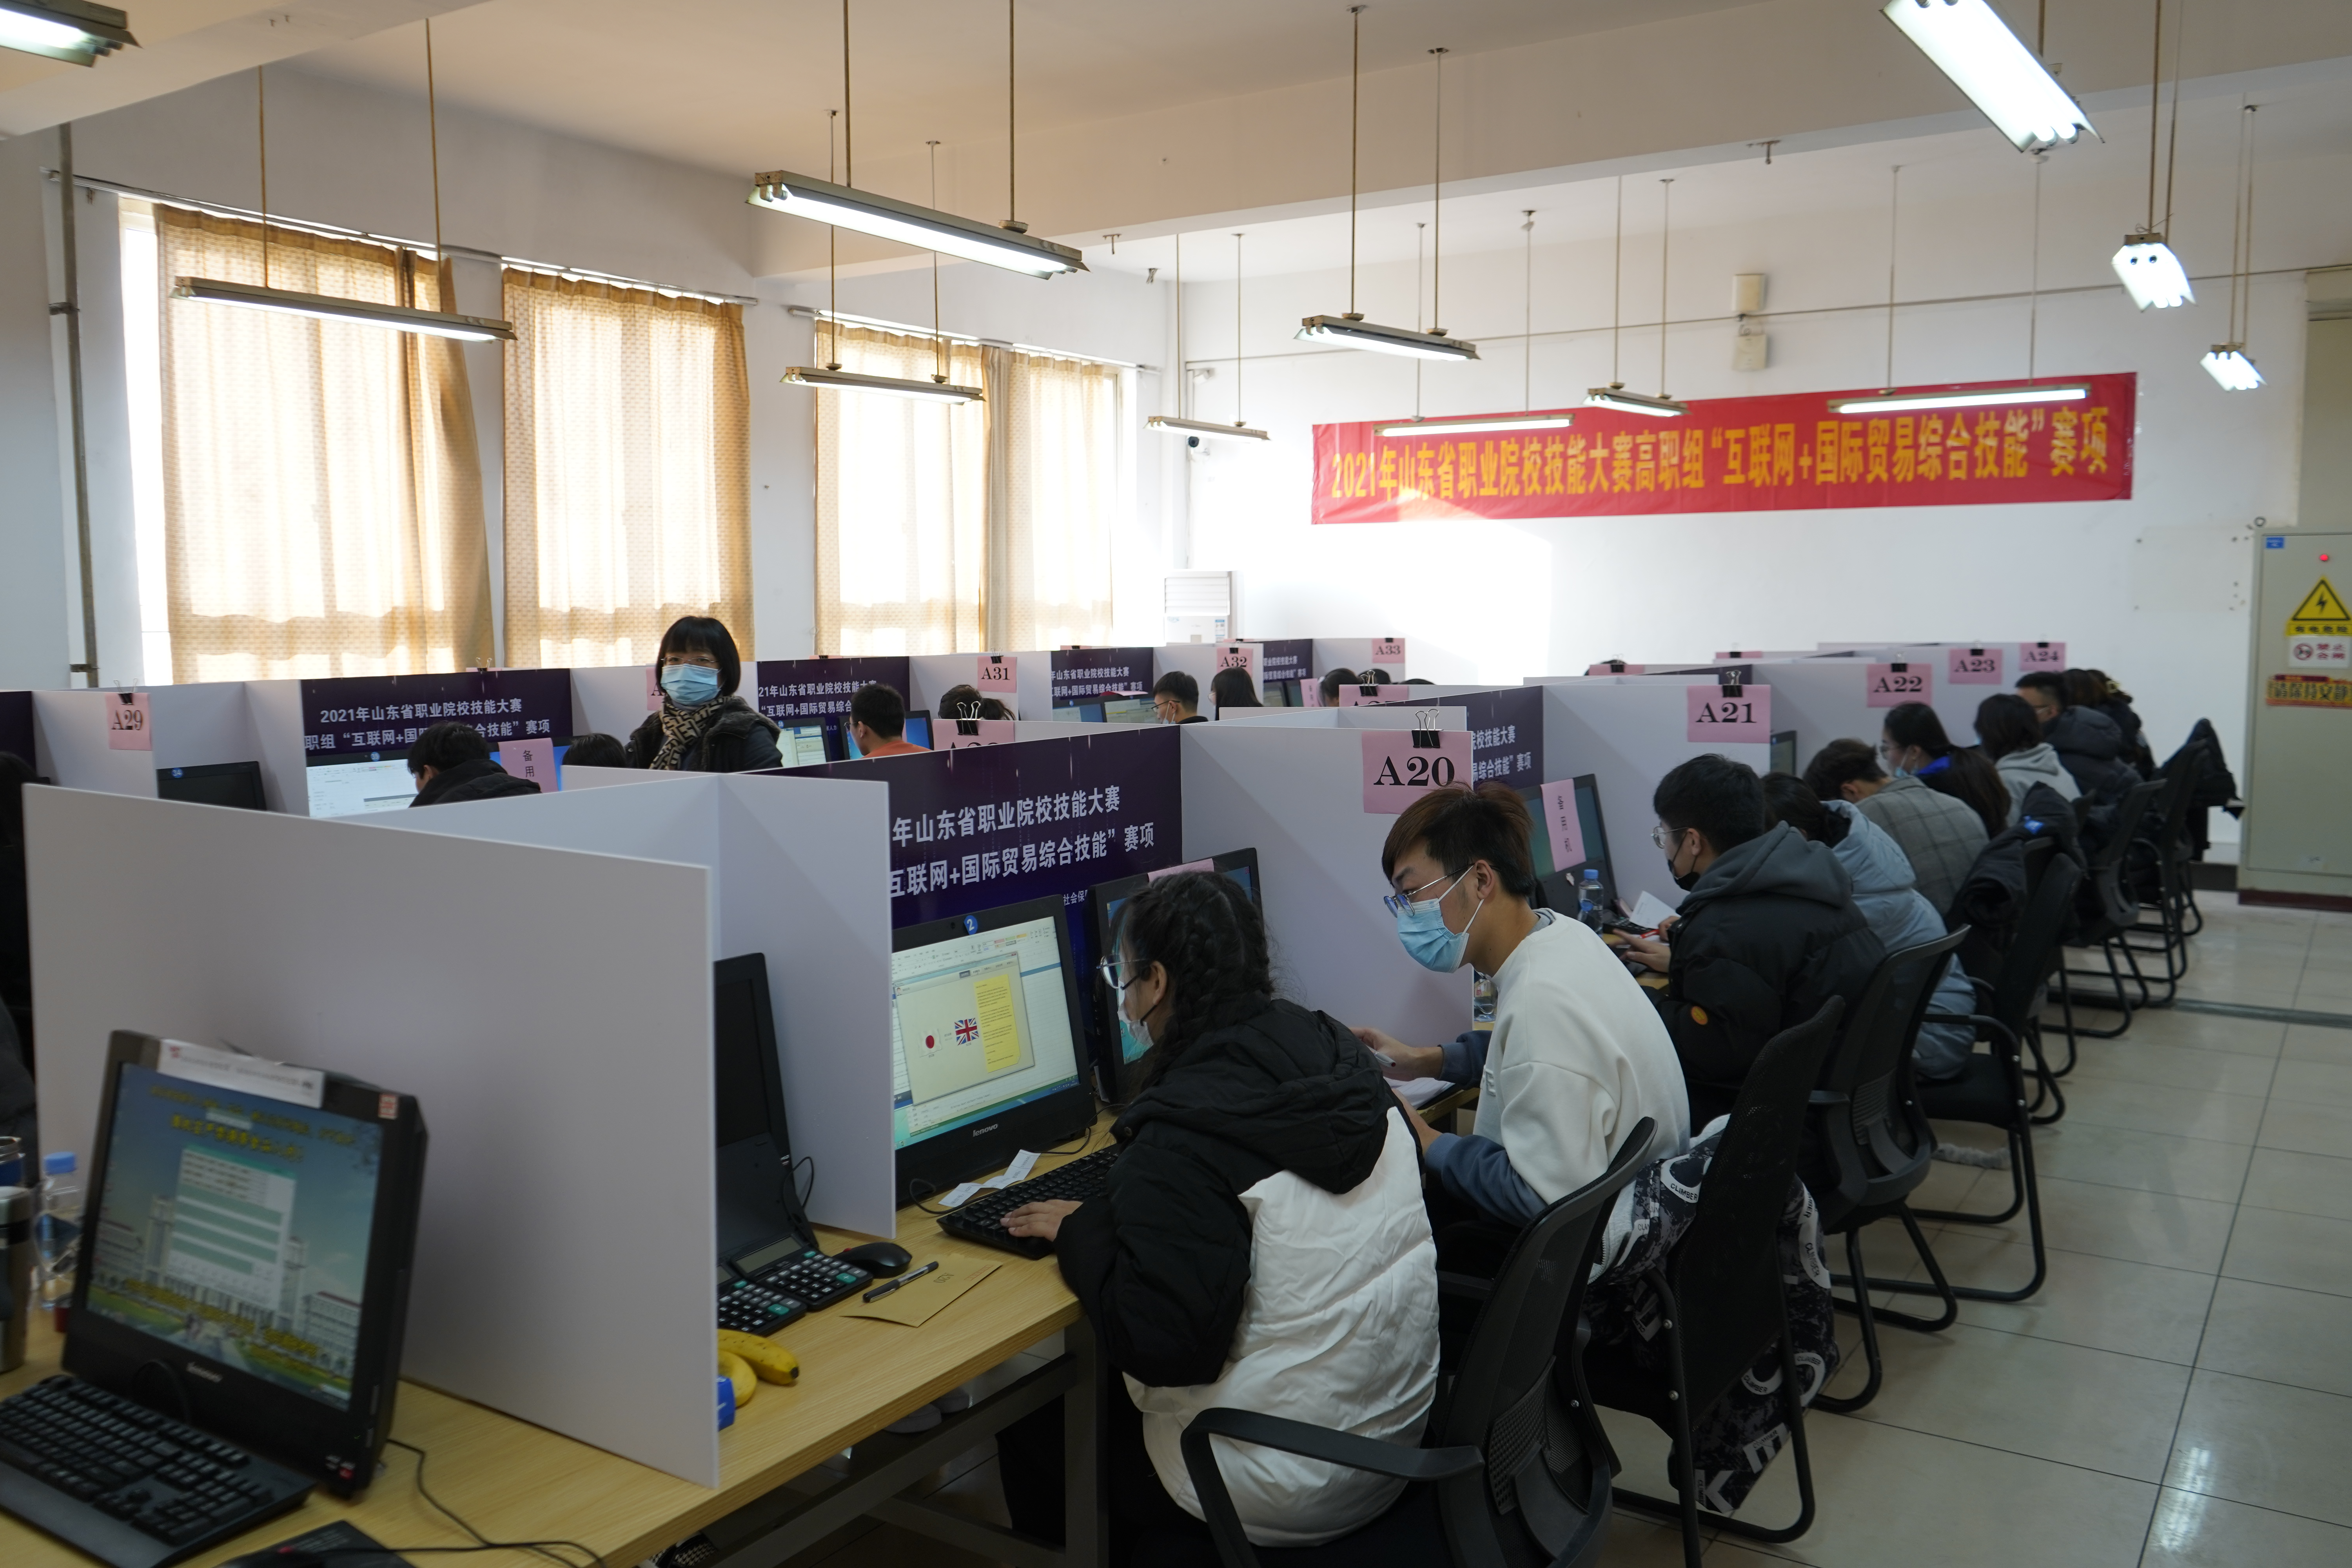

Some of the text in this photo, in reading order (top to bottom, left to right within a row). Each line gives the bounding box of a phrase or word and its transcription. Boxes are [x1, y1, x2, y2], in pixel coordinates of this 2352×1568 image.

[1375, 645, 1401, 656] A33
[2025, 650, 2060, 662] A24
[1220, 656, 1247, 668] A32
[1955, 659, 1995, 673] A23
[981, 667, 1009, 681] A31
[1052, 681, 1143, 697] 联网+国际贸易综合技能”赛项
[1873, 676, 1922, 693] A22
[320, 698, 522, 723] 2021年山东省职业院校技能大赛
[1695, 702, 1757, 723] A21
[111, 710, 143, 731] A29
[523, 750, 535, 777] 备用
[1373, 756, 1455, 786] A20
[893, 785, 1120, 847] 年山东省职业院校技能大赛
[967, 918, 975, 931] 2
[973, 1123, 998, 1137] lenovo
[1670, 1183, 1698, 1202] CLIMBER
